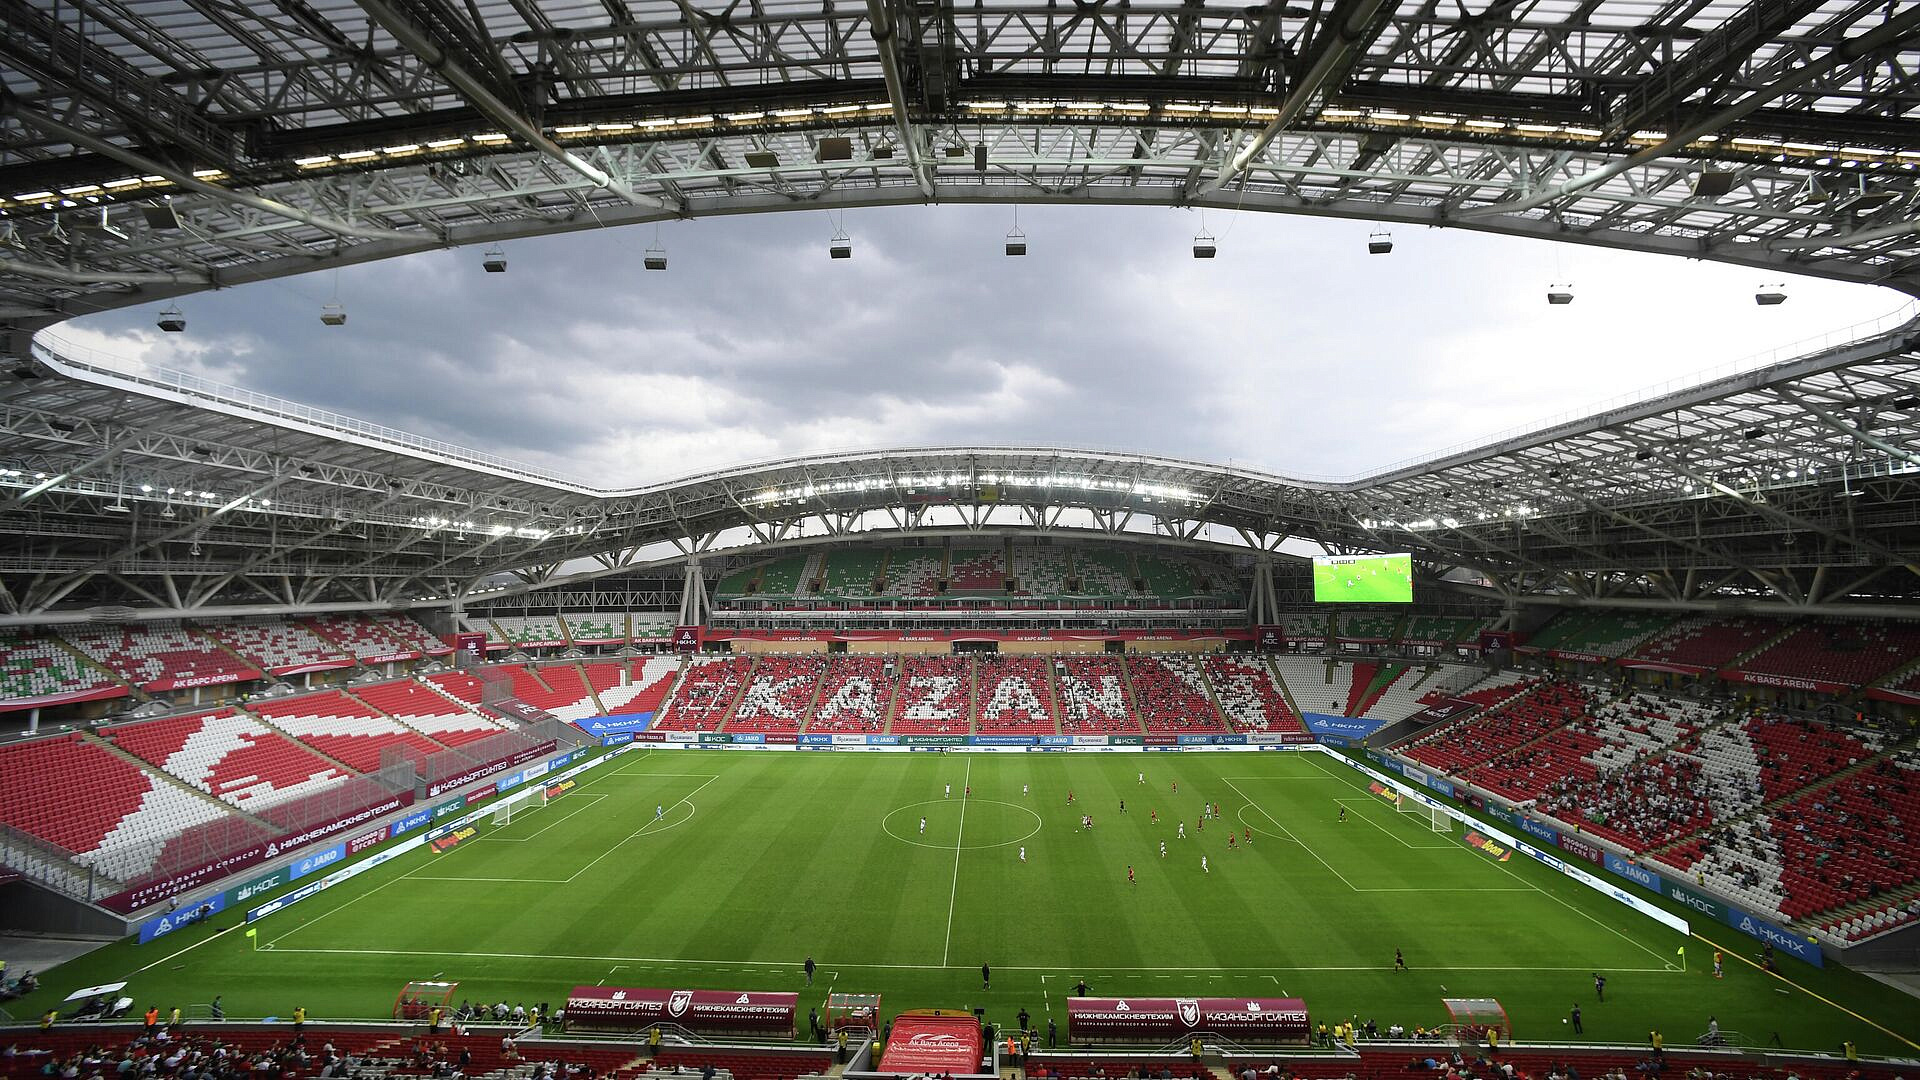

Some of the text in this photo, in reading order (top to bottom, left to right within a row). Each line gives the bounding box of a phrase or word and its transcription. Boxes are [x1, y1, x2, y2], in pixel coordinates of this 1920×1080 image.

[172, 673, 239, 688] АК БАРС АРЕНА
[1744, 674, 1816, 690] AK BARS ARENA
[735, 675, 1129, 720] KAZAN
[440, 761, 507, 793] КАЗАНЬОРГСИНТЕЗ
[444, 801, 461, 813] КОС
[406, 814, 427, 828] НКНХ
[1496, 810, 1512, 823] КОС
[280, 800, 399, 850] НИЖНЕКАМСКНЕФТЕХИМ
[1530, 826, 1552, 840] НКНХ
[313, 850, 337, 867] JAKO
[131, 849, 260, 900] ГЕНЕРАЛЬНЫЙ СПОНСОР
[1624, 866, 1650, 884] JAKO
[252, 875, 280, 895] КОС
[131, 897, 147, 908] ФК
[1686, 895, 1716, 917] КОС
[1759, 926, 1805, 955] НКНХ
[568, 1000, 663, 1011] КАЗАНЬОРГСИНТЕЗ
[693, 1005, 789, 1013] НИЖНЕКАМСКНЕФТЕХИМ
[1206, 1012, 1307, 1022] КАЗАНЬОРГСИНТЕЗ
